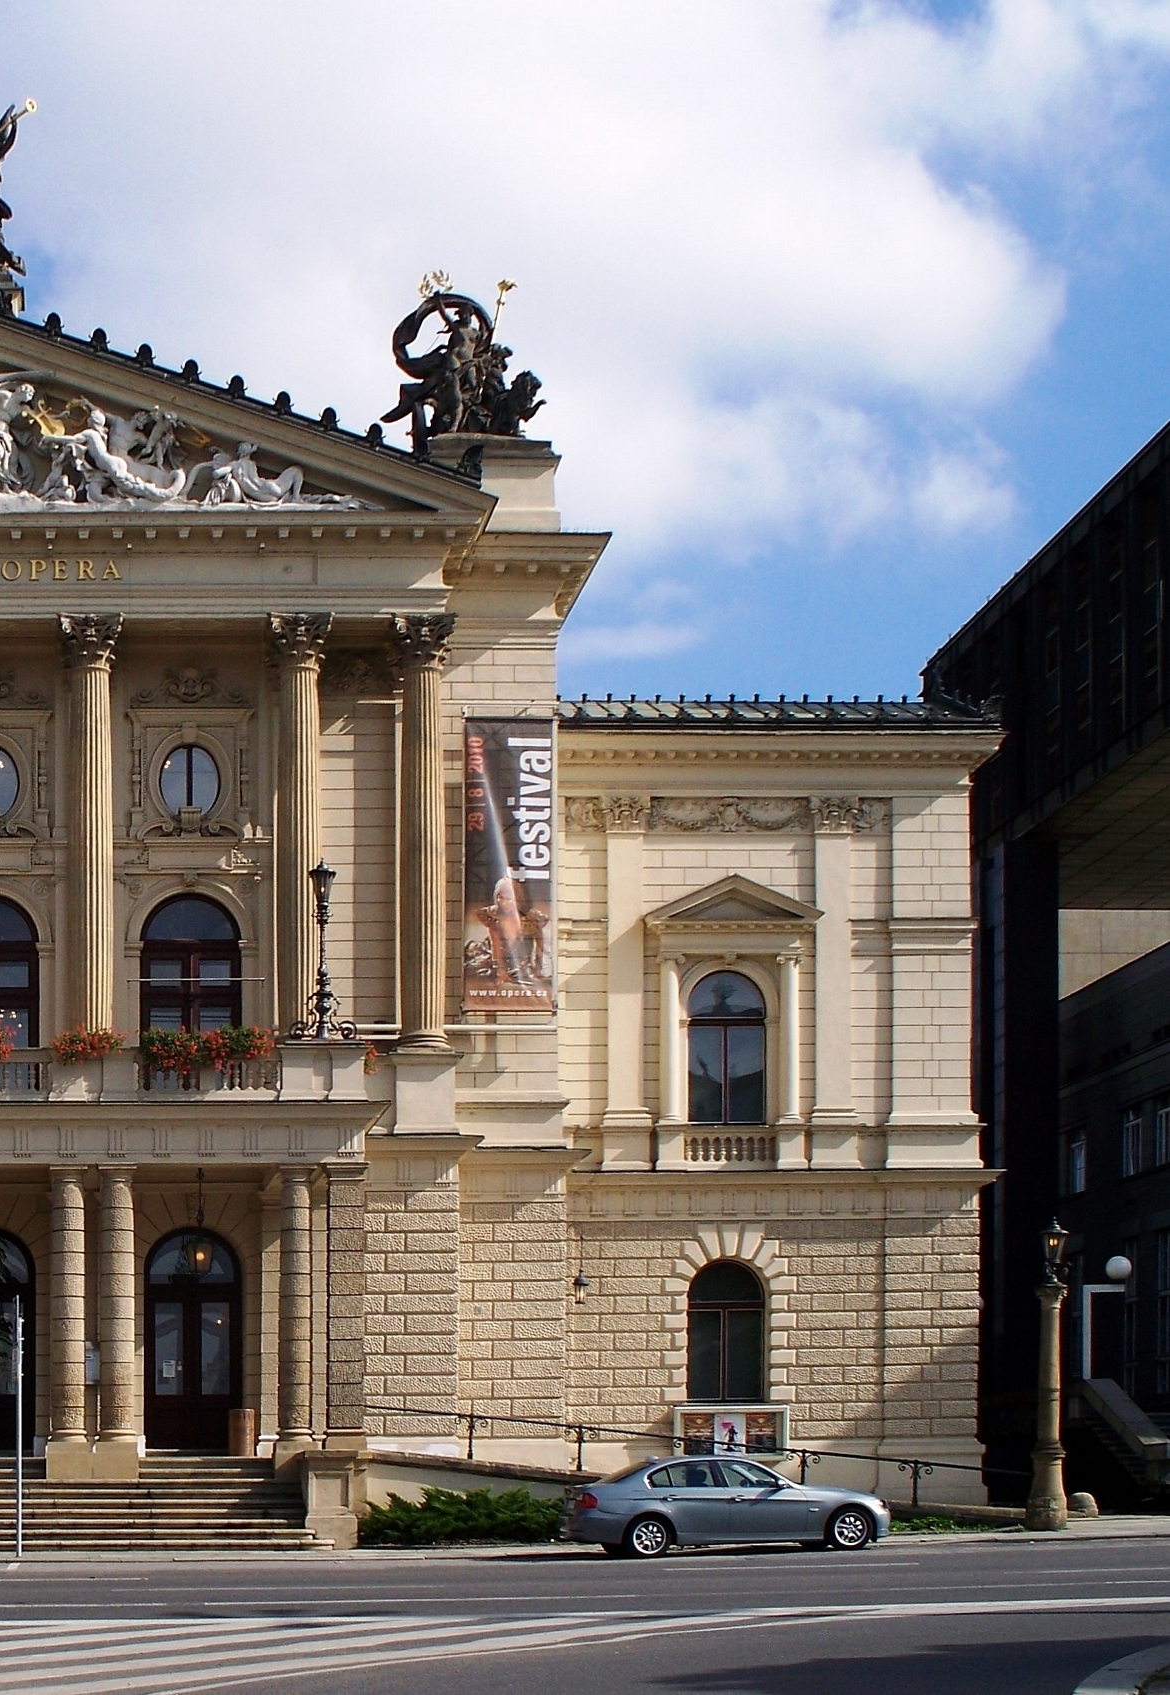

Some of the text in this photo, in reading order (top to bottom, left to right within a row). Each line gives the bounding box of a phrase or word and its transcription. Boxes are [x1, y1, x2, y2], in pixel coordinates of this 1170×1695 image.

[1, 558, 122, 581] OPERA
[468, 736, 484, 831] 29 8 2010
[506, 737, 552, 882] festival
[469, 989, 548, 998] www.opera.cz
